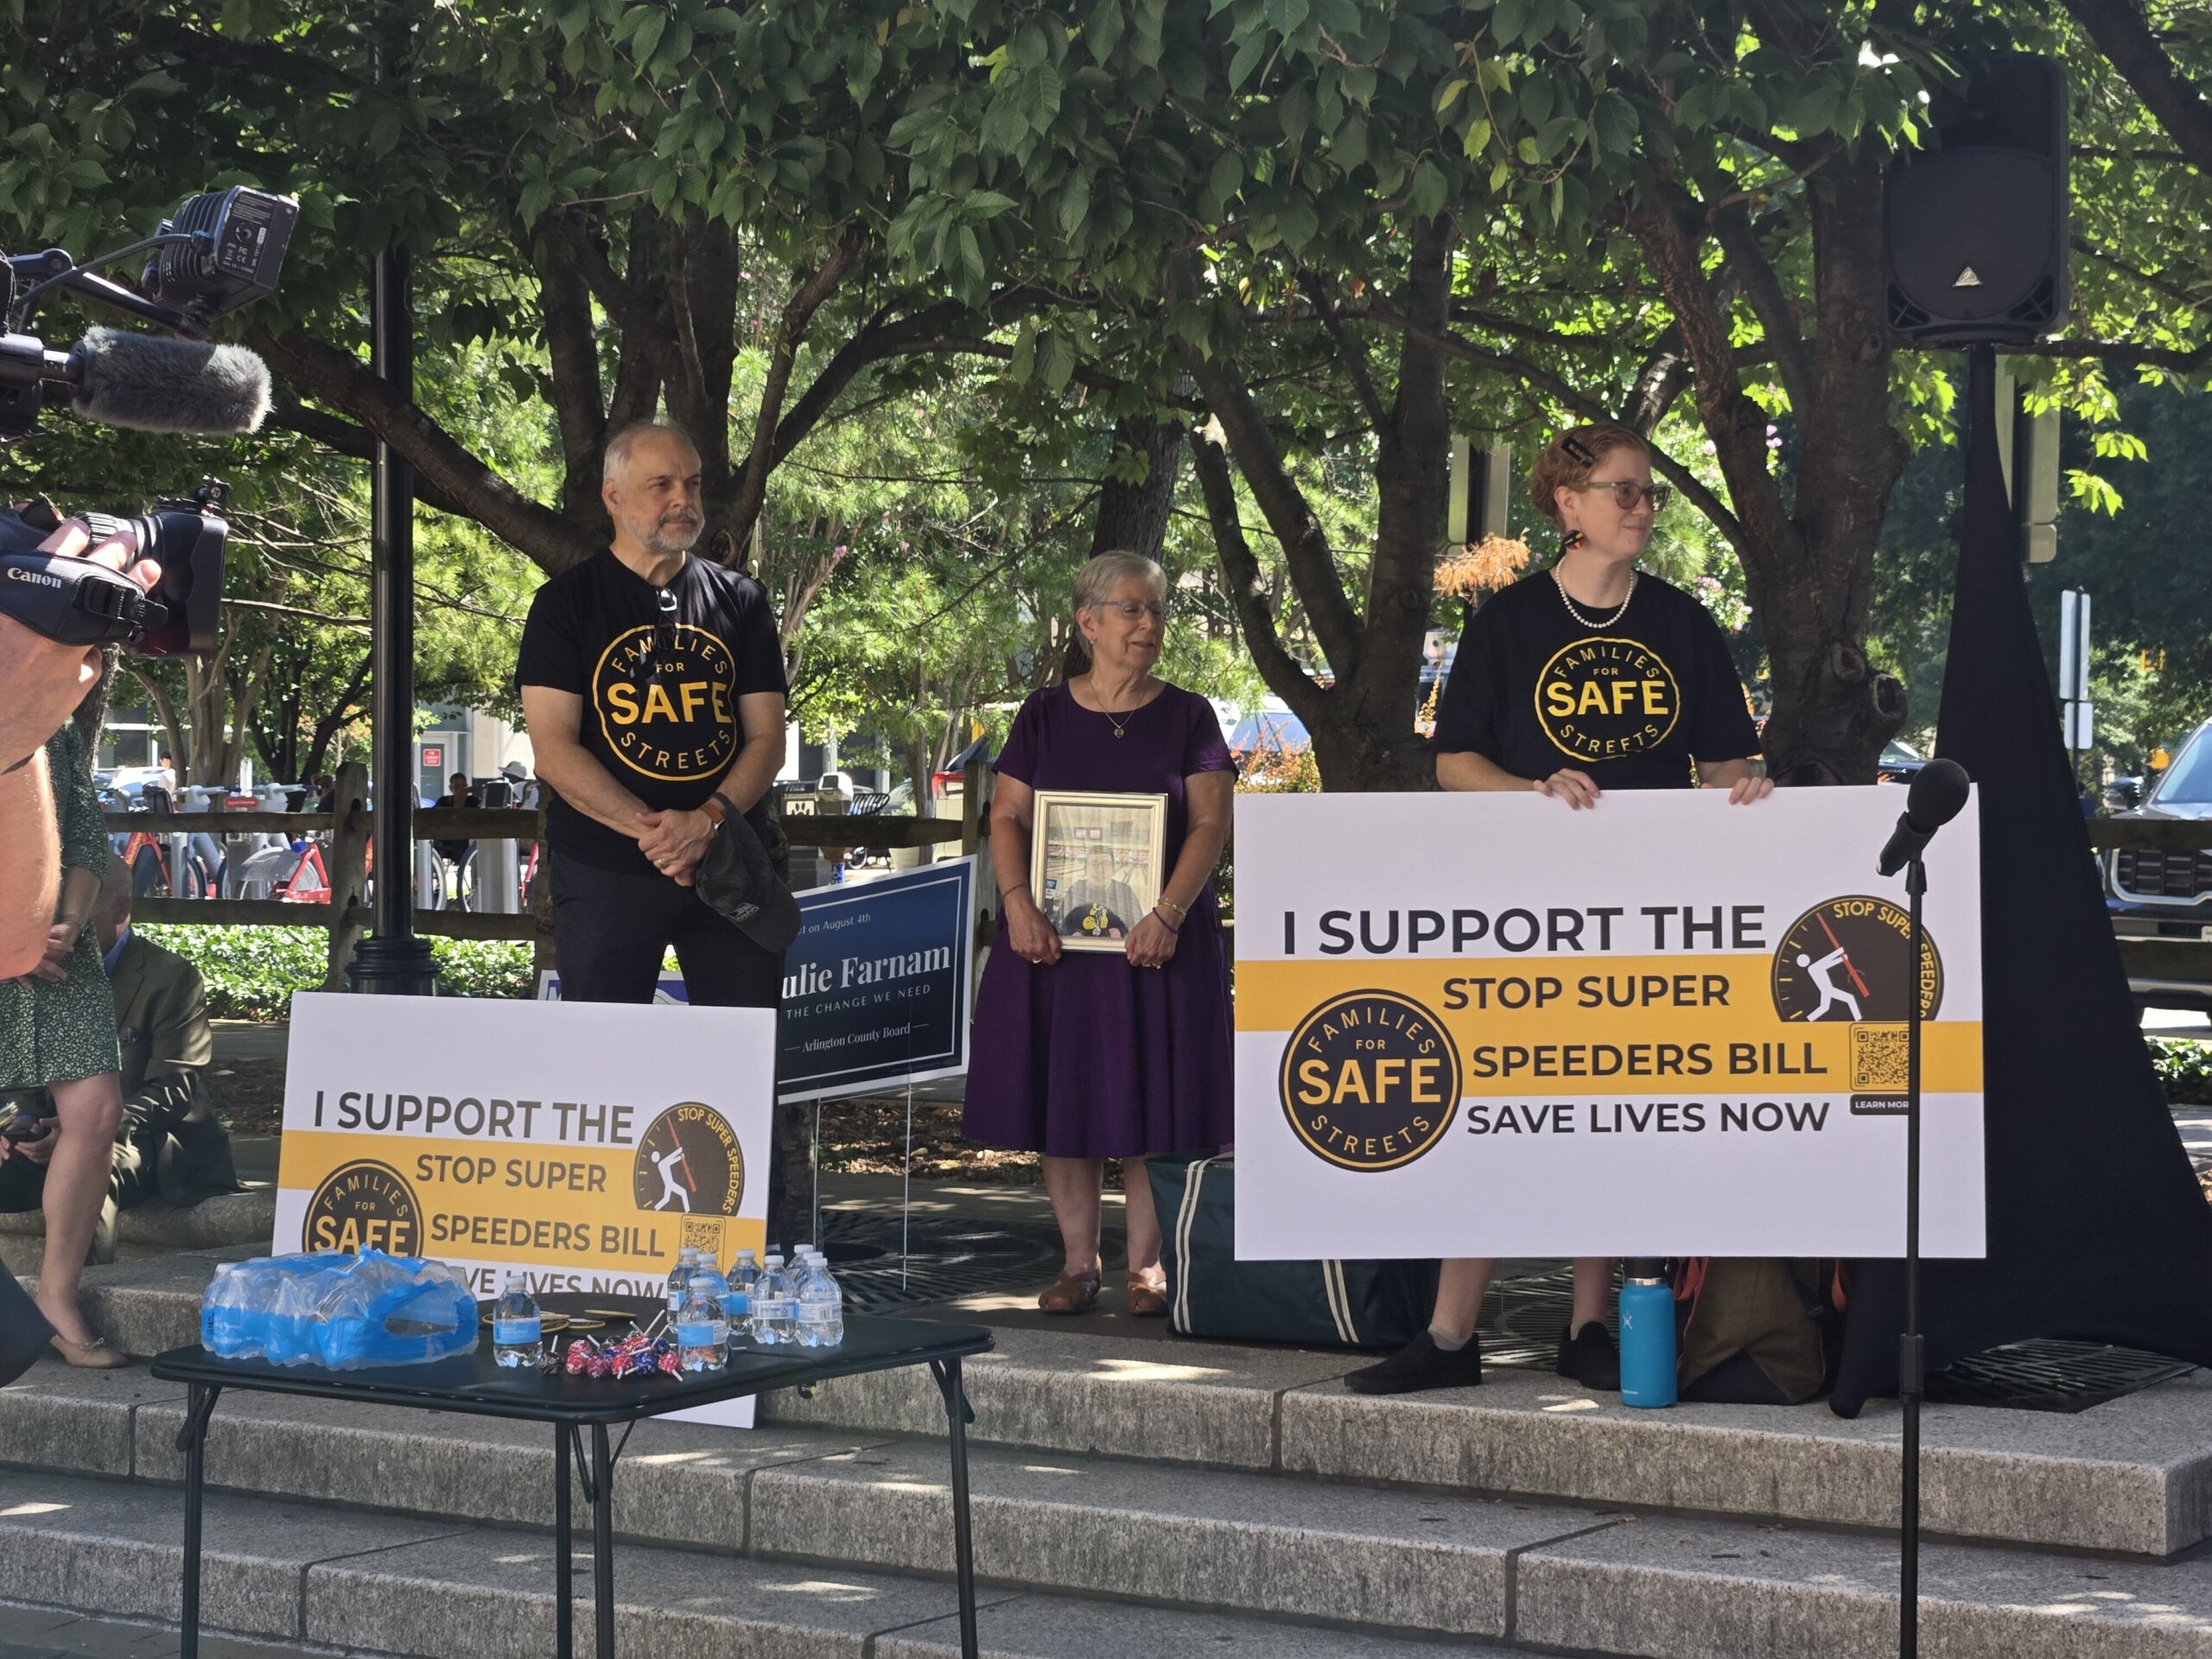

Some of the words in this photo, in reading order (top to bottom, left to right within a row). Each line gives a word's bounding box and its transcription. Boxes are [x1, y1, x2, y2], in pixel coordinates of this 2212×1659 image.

[7, 567, 62, 588] Canon
[611, 635, 728, 674] FAMLIES
[656, 662, 684, 673] FOR
[1554, 646, 1659, 677] FAMILIES
[607, 681, 732, 725] SAFE
[1547, 681, 1669, 717] SAFE
[621, 729, 730, 769] STREETS
[808, 925, 820, 933] on
[823, 917, 854, 931] August
[857, 913, 871, 923] 4th
[1285, 912, 1294, 954] I
[1319, 908, 1623, 954] SUPPORT
[1641, 906, 1765, 949] THE
[1833, 901, 1875, 918] STOP
[1877, 906, 1910, 939] SUPE
[781, 963, 832, 1000] ulie
[840, 946, 950, 988] Farnam
[1444, 977, 1561, 1009] STOP
[1578, 975, 1729, 1007] SUPER
[786, 1007, 809, 1020] THE
[816, 996, 868, 1014] CHANGE
[874, 992, 891, 1003] WE
[899, 984, 931, 998] NEED
[803, 1037, 845, 1052] Arlington
[848, 1029, 881, 1044] County
[883, 1023, 910, 1038] Board
[1308, 1007, 1435, 1053] FAMILIES
[1356, 1039, 1385, 1050] FOR
[1473, 1044, 1712, 1077] SPEEDERS
[1730, 1043, 1827, 1074] BILL
[1298, 1058, 1440, 1104] SAFE
[315, 1091, 323, 1127] I
[338, 1092, 541, 1137] SUPPORT
[553, 1103, 633, 1143] THE
[1311, 1115, 1429, 1155] STREETS
[1468, 1105, 1574, 1134] SAVE
[1591, 1103, 1705, 1132] LIVES
[1721, 1103, 1829, 1131] NOW
[416, 1154, 495, 1184] STOP
[506, 1160, 606, 1192] SUPER
[677, 1108, 705, 1122] STOP
[706, 1113, 733, 1147] SUPER
[722, 1147, 740, 1214] SPEEDERS
[324, 1174, 408, 1217] FAMILIES
[355, 1202, 376, 1211] FOR
[314, 1215, 410, 1257] SAFE
[431, 1214, 589, 1250] SPEEDERS
[601, 1226, 664, 1256] BILL
[464, 1268, 496, 1294] VE
[506, 1270, 582, 1294] IVES
[592, 1276, 664, 1299] NOW
